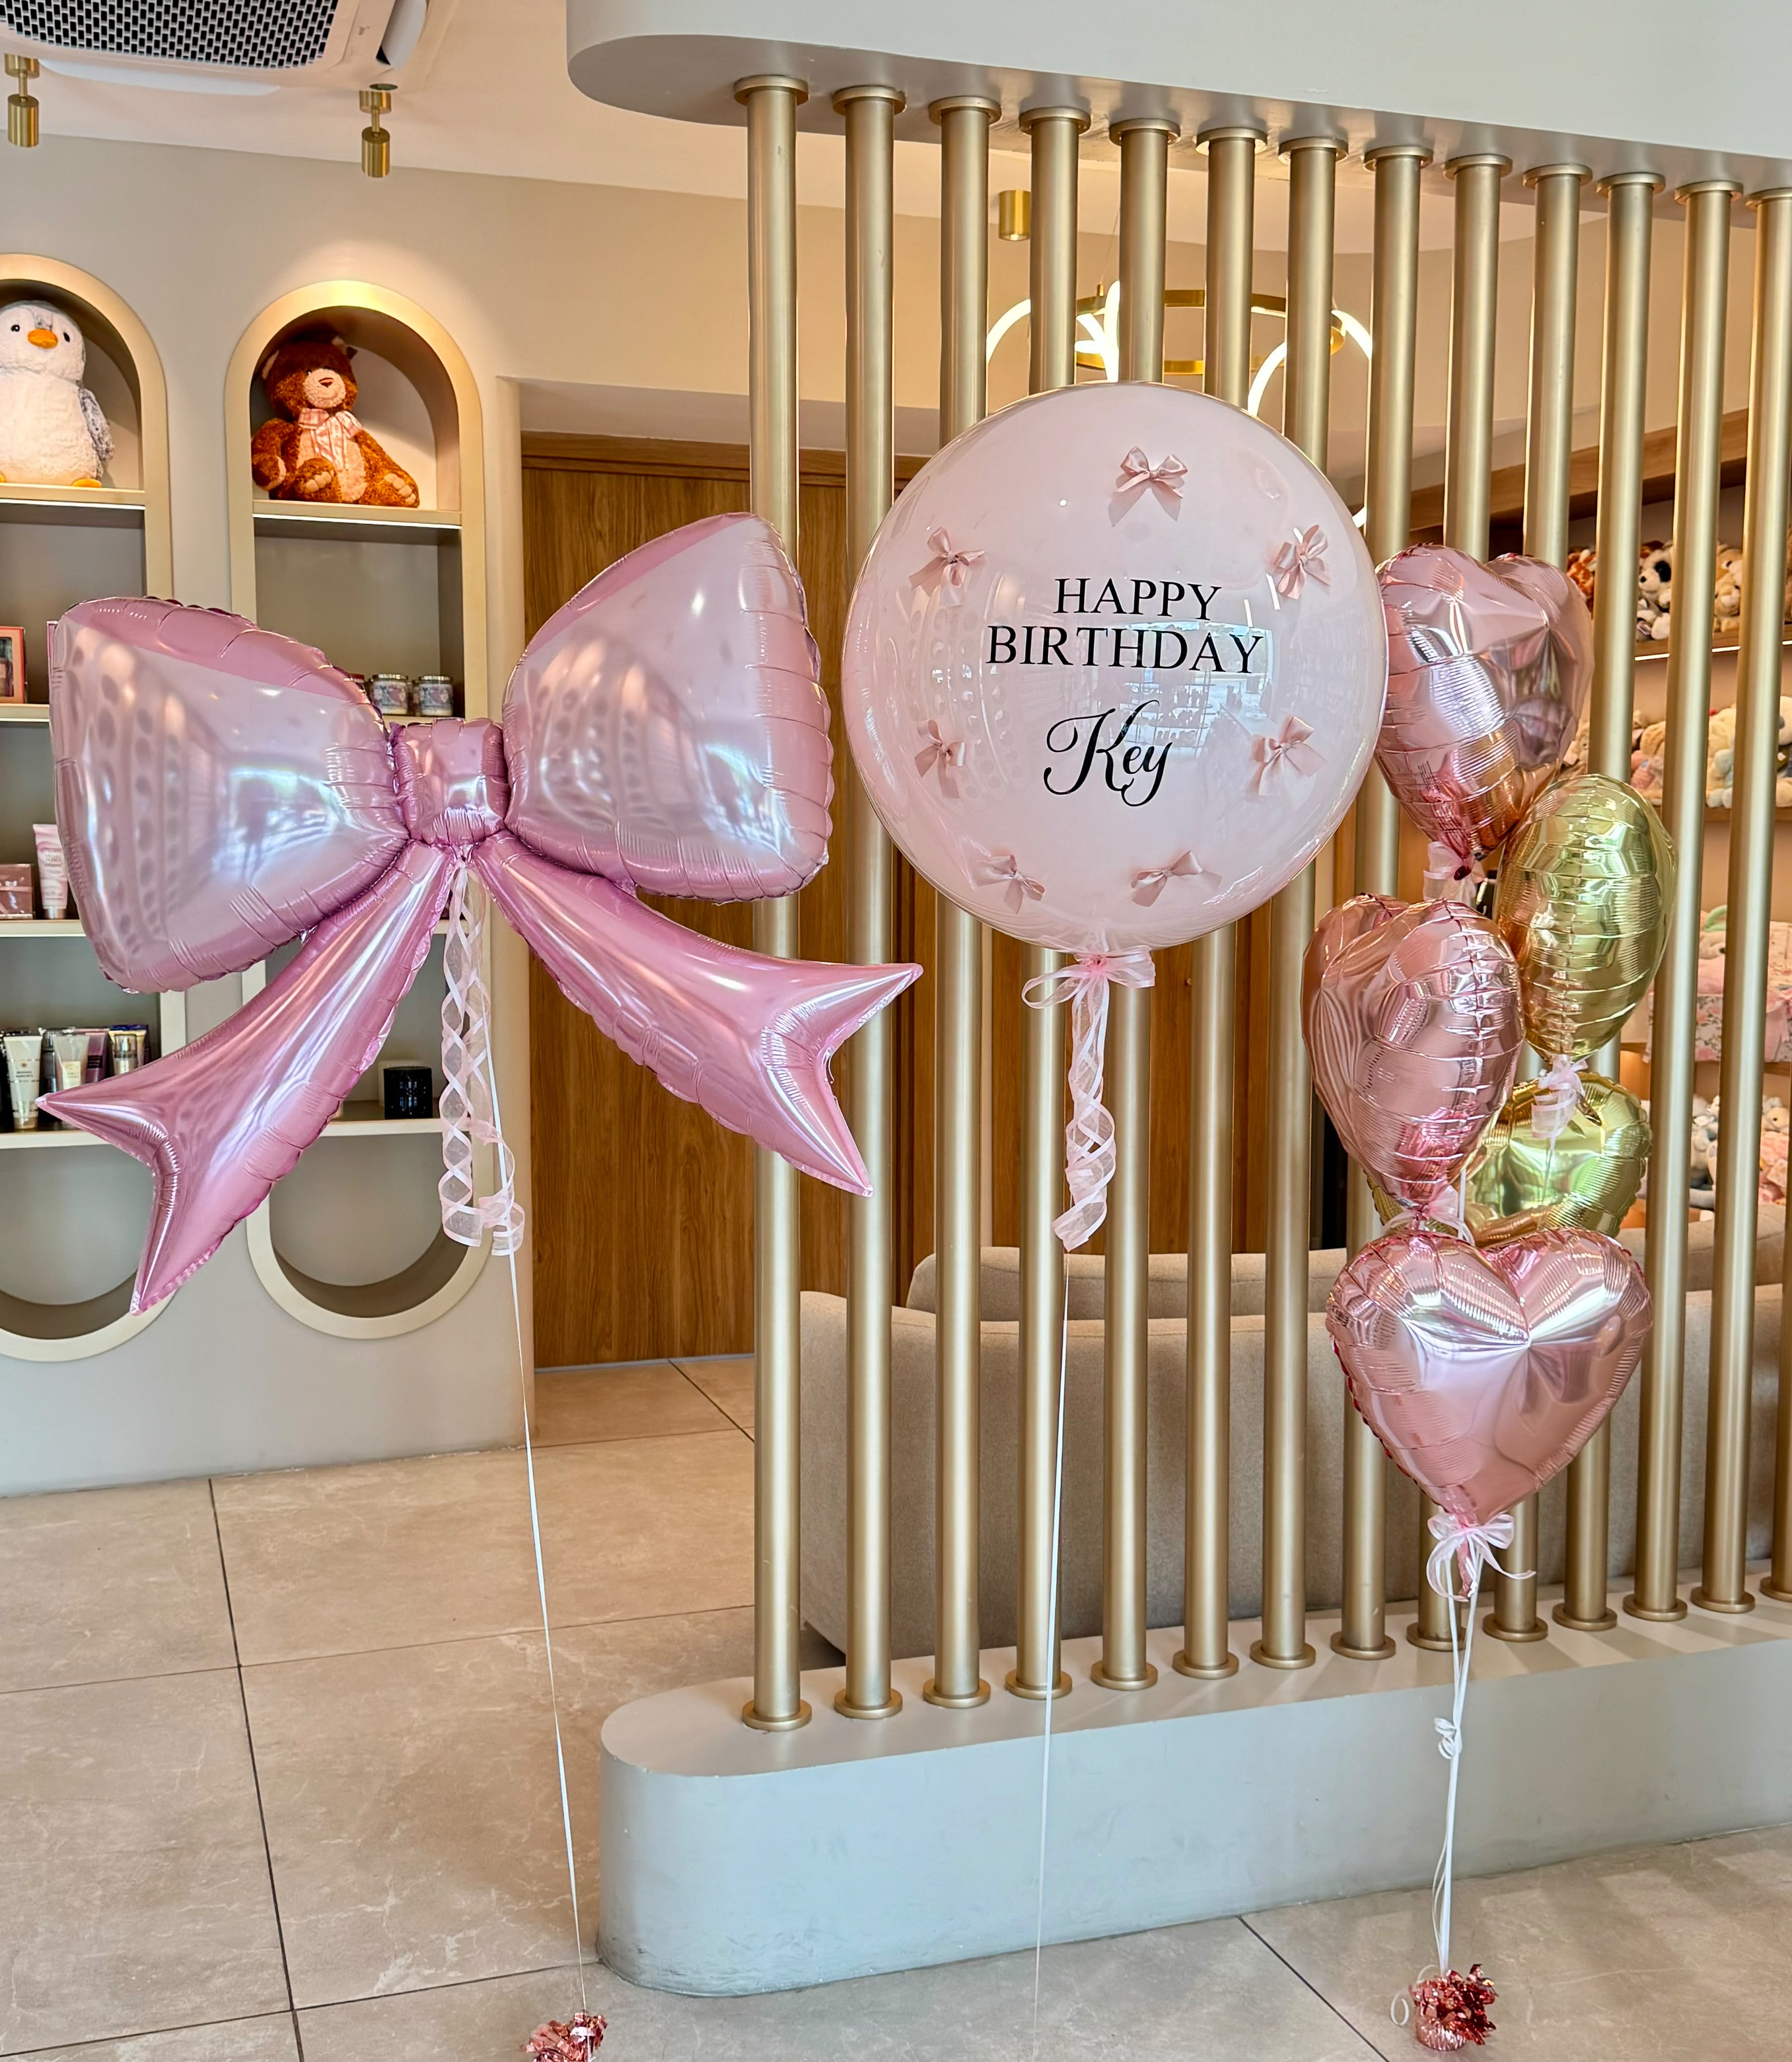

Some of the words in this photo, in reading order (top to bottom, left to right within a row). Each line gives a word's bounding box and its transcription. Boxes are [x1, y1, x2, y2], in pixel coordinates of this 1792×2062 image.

[1053, 577, 1222, 621] HAPPY
[986, 625, 1264, 674] BIRTHDAY
[1043, 699, 1173, 807] Key
